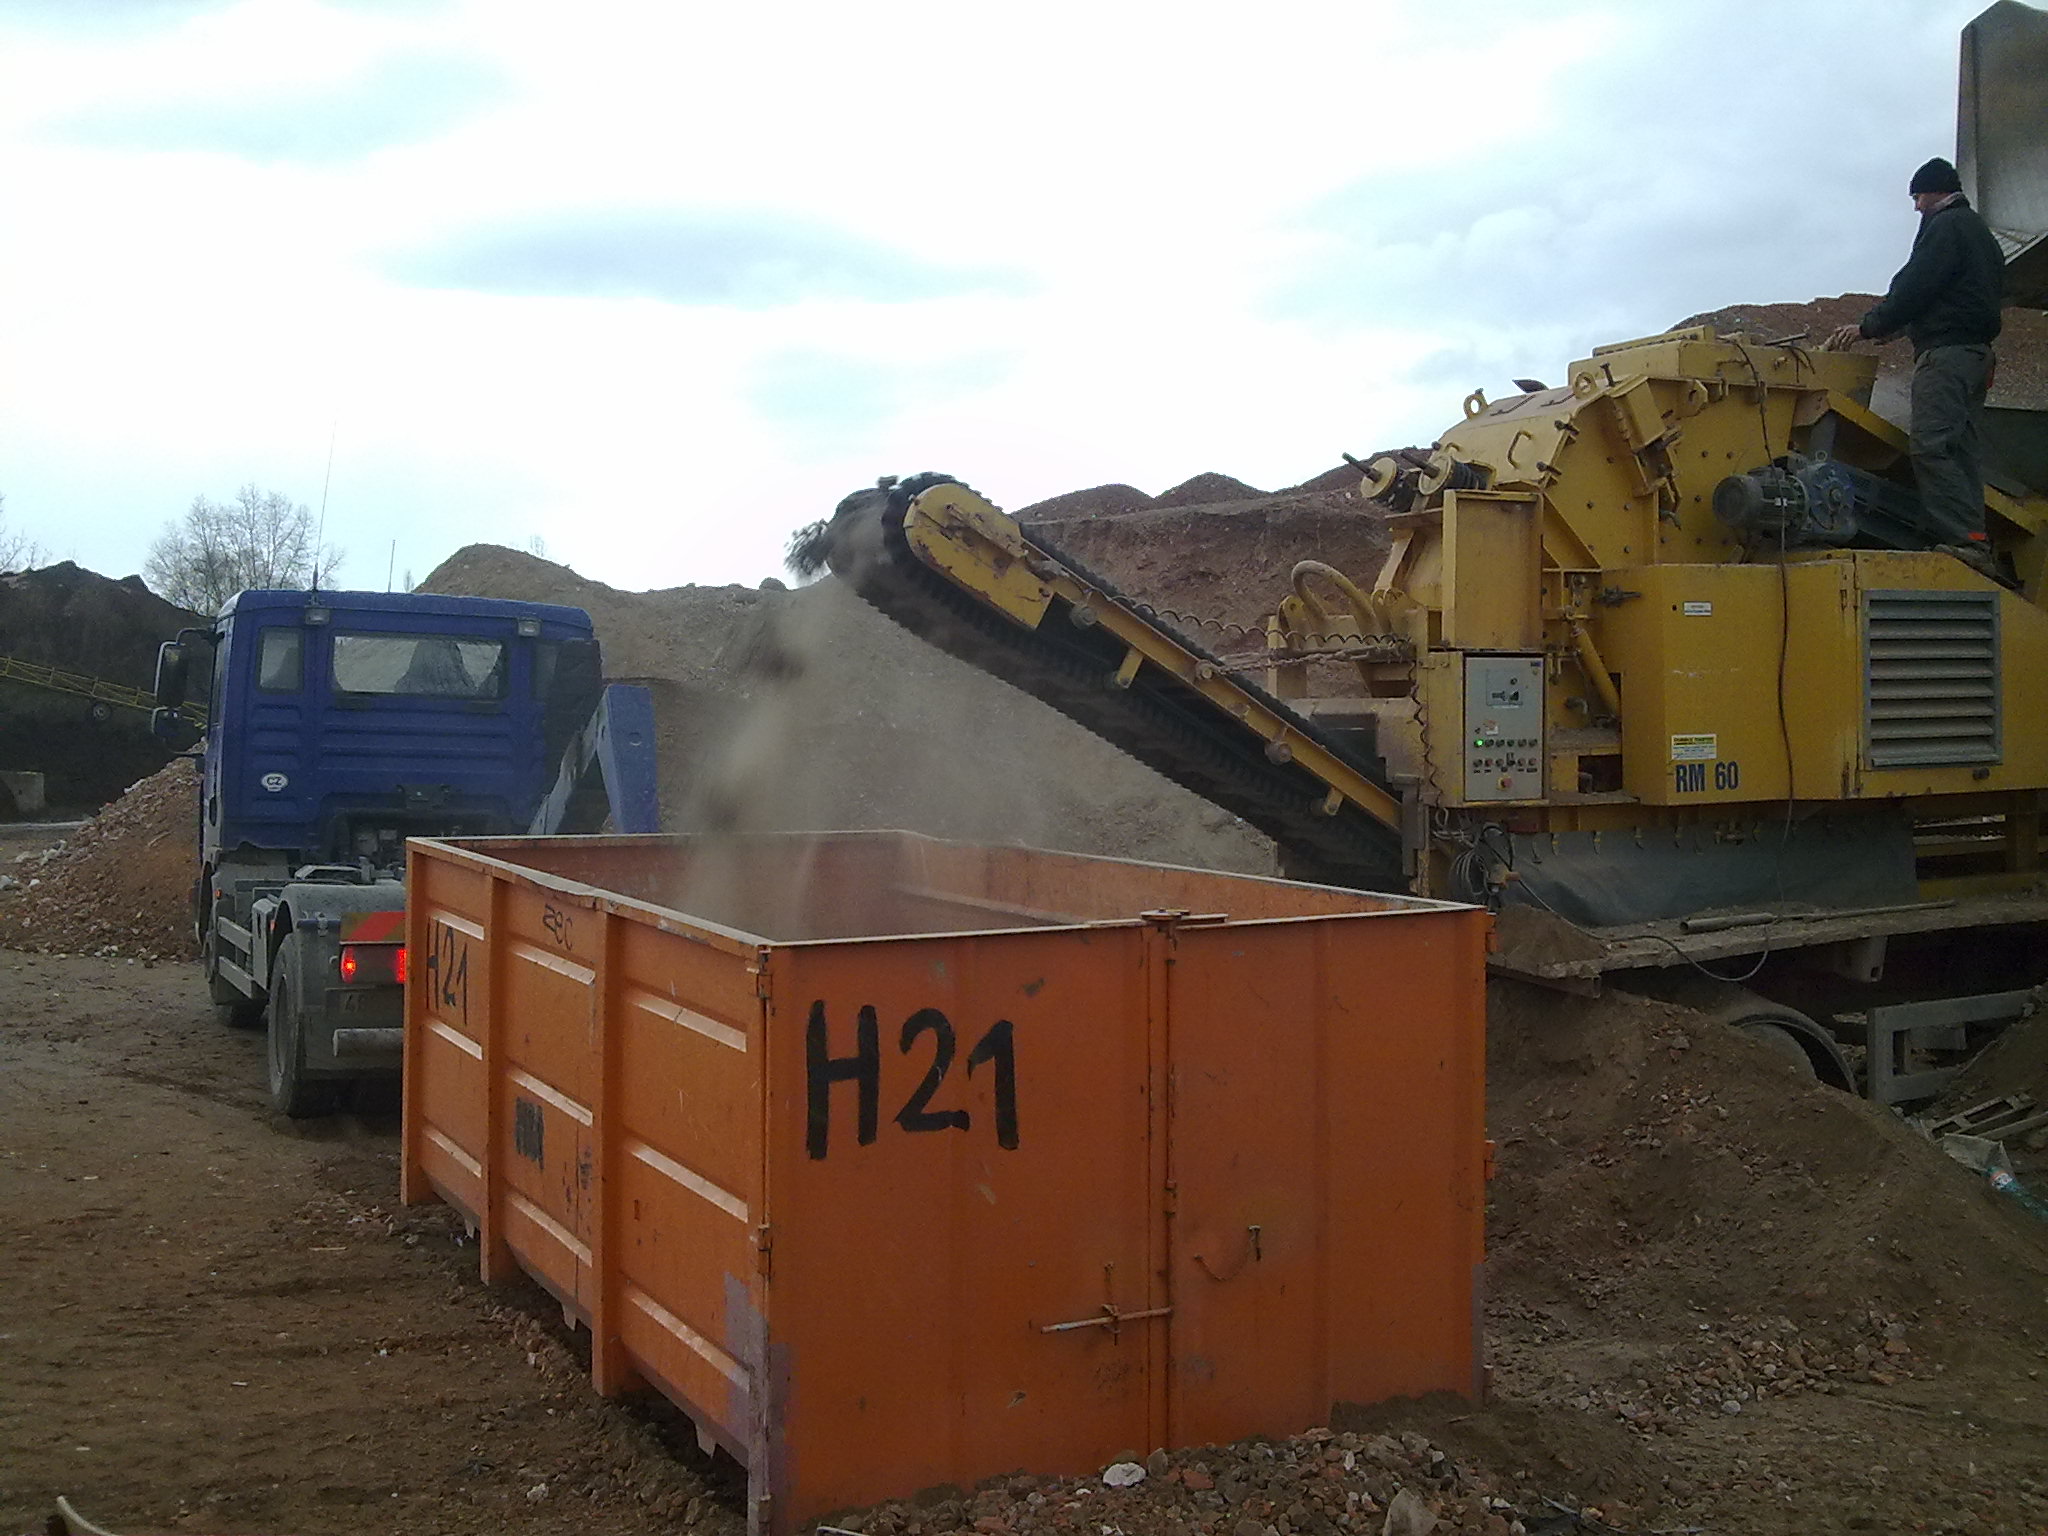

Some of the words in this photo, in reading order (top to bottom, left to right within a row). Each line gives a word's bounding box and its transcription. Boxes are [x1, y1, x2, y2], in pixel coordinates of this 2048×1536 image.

[266, 775, 283, 786] CZ
[1676, 763, 1705, 793] RM
[1715, 760, 1739, 790] 60
[426, 916, 468, 1027] H21
[806, 999, 1019, 1160] H21
